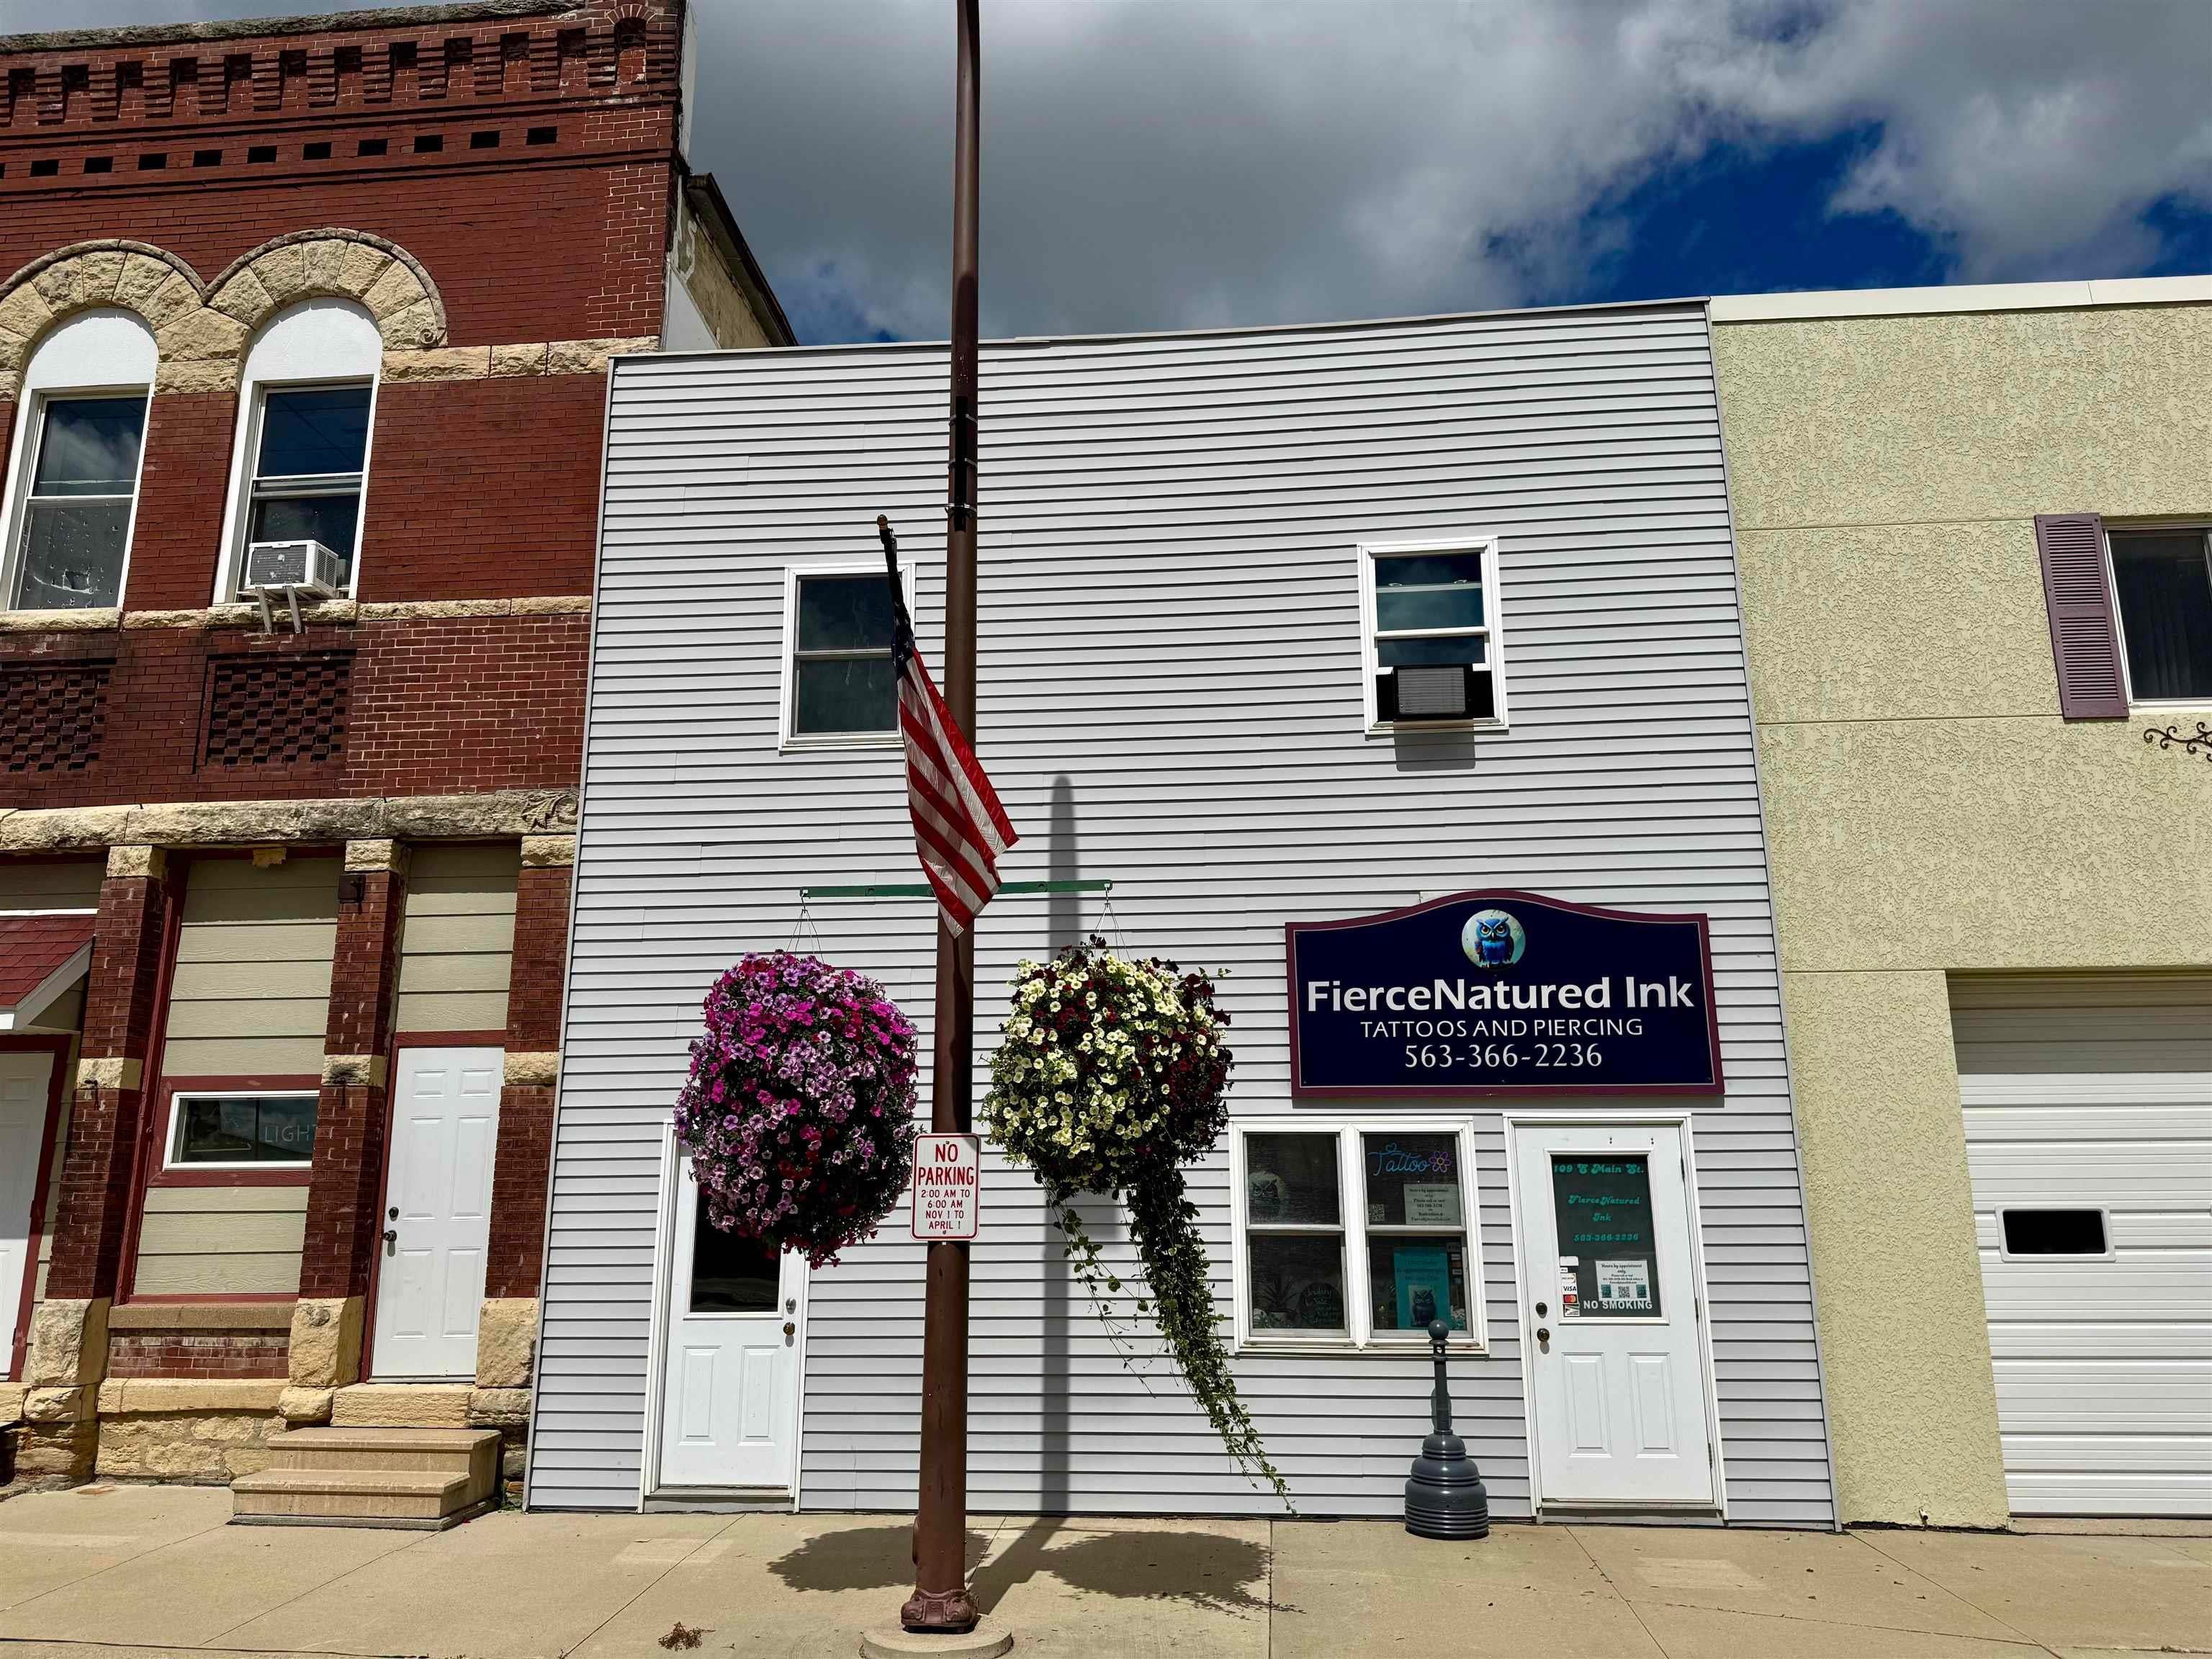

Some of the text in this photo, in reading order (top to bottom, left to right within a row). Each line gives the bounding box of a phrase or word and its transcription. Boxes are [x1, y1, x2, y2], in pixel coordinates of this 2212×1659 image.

[1307, 976, 1694, 1012] FierceNatured Ink
[1360, 1018, 1643, 1038] TATTOOS AND PIERCING
[1404, 1043, 1603, 1068] 563-366-2236
[264, 1124, 317, 1143] LIGH
[935, 1143, 958, 1162] NO
[1367, 1149, 1431, 1176] Tattoo
[1554, 1164, 1573, 1173] 109
[1591, 1163, 1622, 1174] Main
[918, 1166, 974, 1185] PARKING
[921, 1190, 940, 1198] 2:00
[927, 1200, 946, 1208] 6:00
[1583, 1300, 1653, 1310] NO SMOKING
